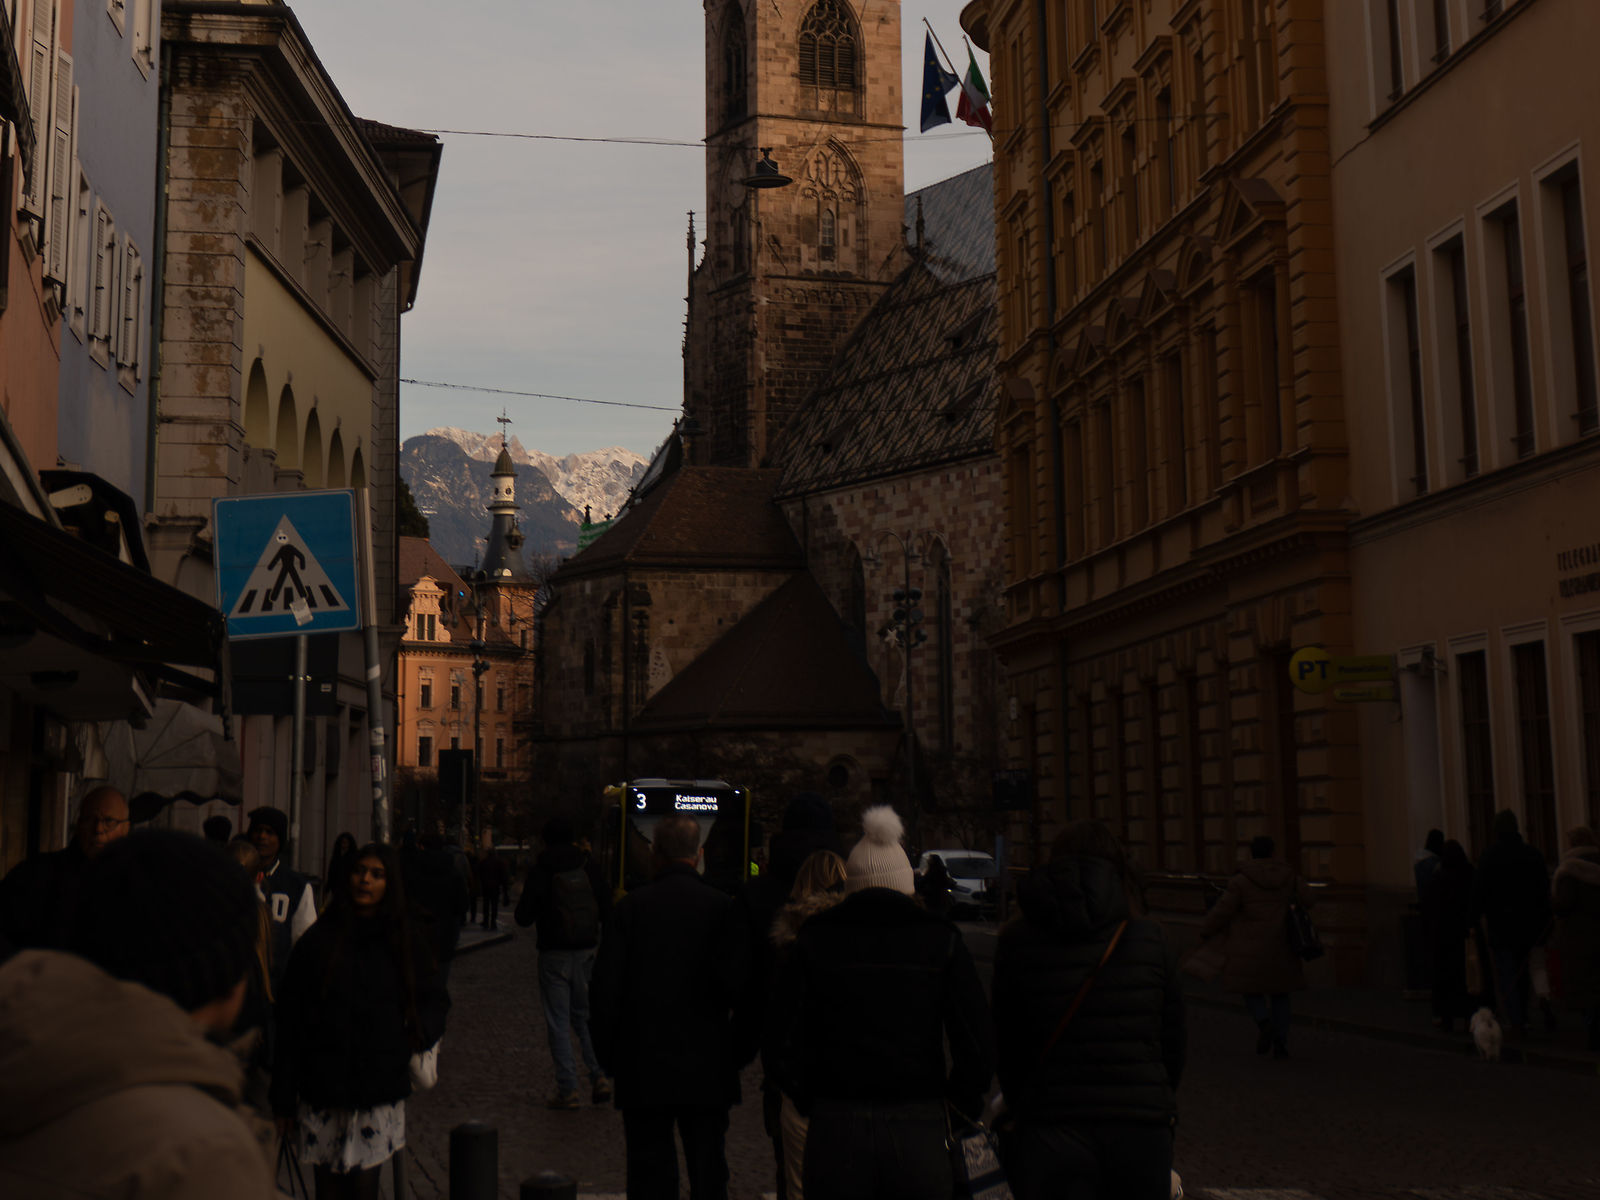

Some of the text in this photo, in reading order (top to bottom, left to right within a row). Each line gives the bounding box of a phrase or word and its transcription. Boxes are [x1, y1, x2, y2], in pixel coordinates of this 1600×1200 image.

[1298, 660, 1330, 680] PT
[636, 793, 647, 809] 3
[676, 794, 717, 803] Kaiserau
[675, 802, 718, 810] Casanova
